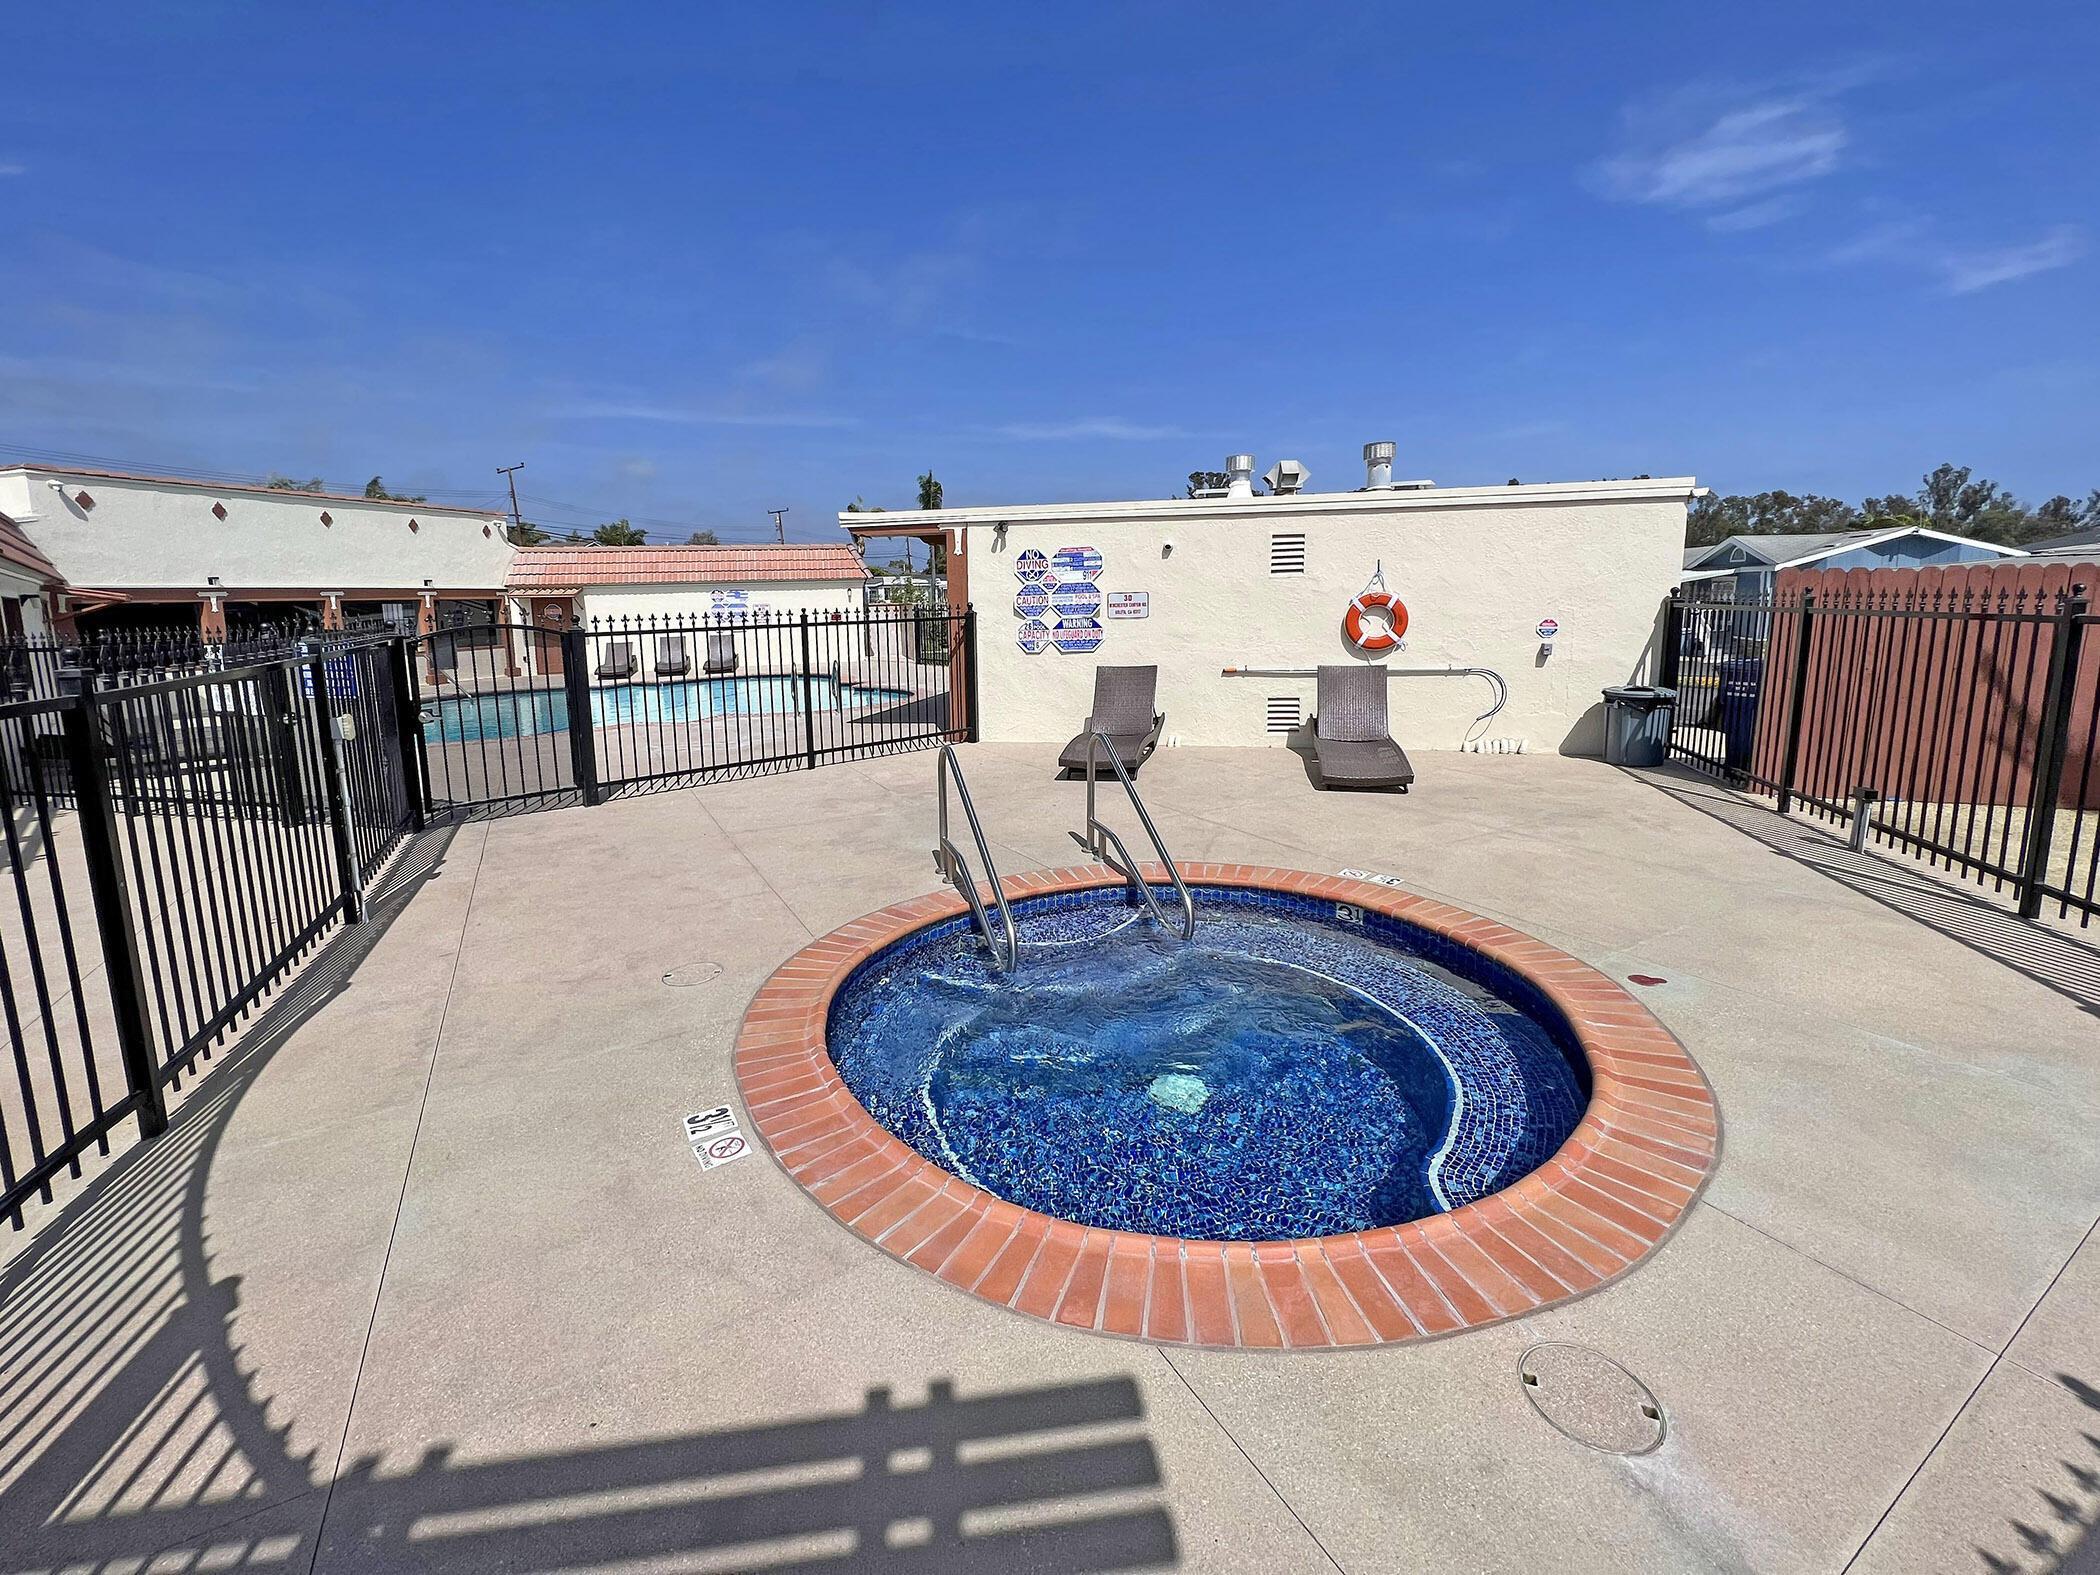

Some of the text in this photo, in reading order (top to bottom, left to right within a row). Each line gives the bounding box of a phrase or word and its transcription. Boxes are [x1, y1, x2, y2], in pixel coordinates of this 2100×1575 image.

[1026, 550, 1039, 560] NO
[1016, 560, 1049, 570] DIVING
[1083, 571, 1092, 580] 911
[1016, 596, 1049, 606] CAUTION
[1063, 619, 1093, 629] WARNING
[1018, 630, 1050, 640] CAPACITY
[1053, 631, 1060, 639] NO
[1060, 630, 1083, 639] LIFEGUARD
[1092, 629, 1103, 639] DUTY
